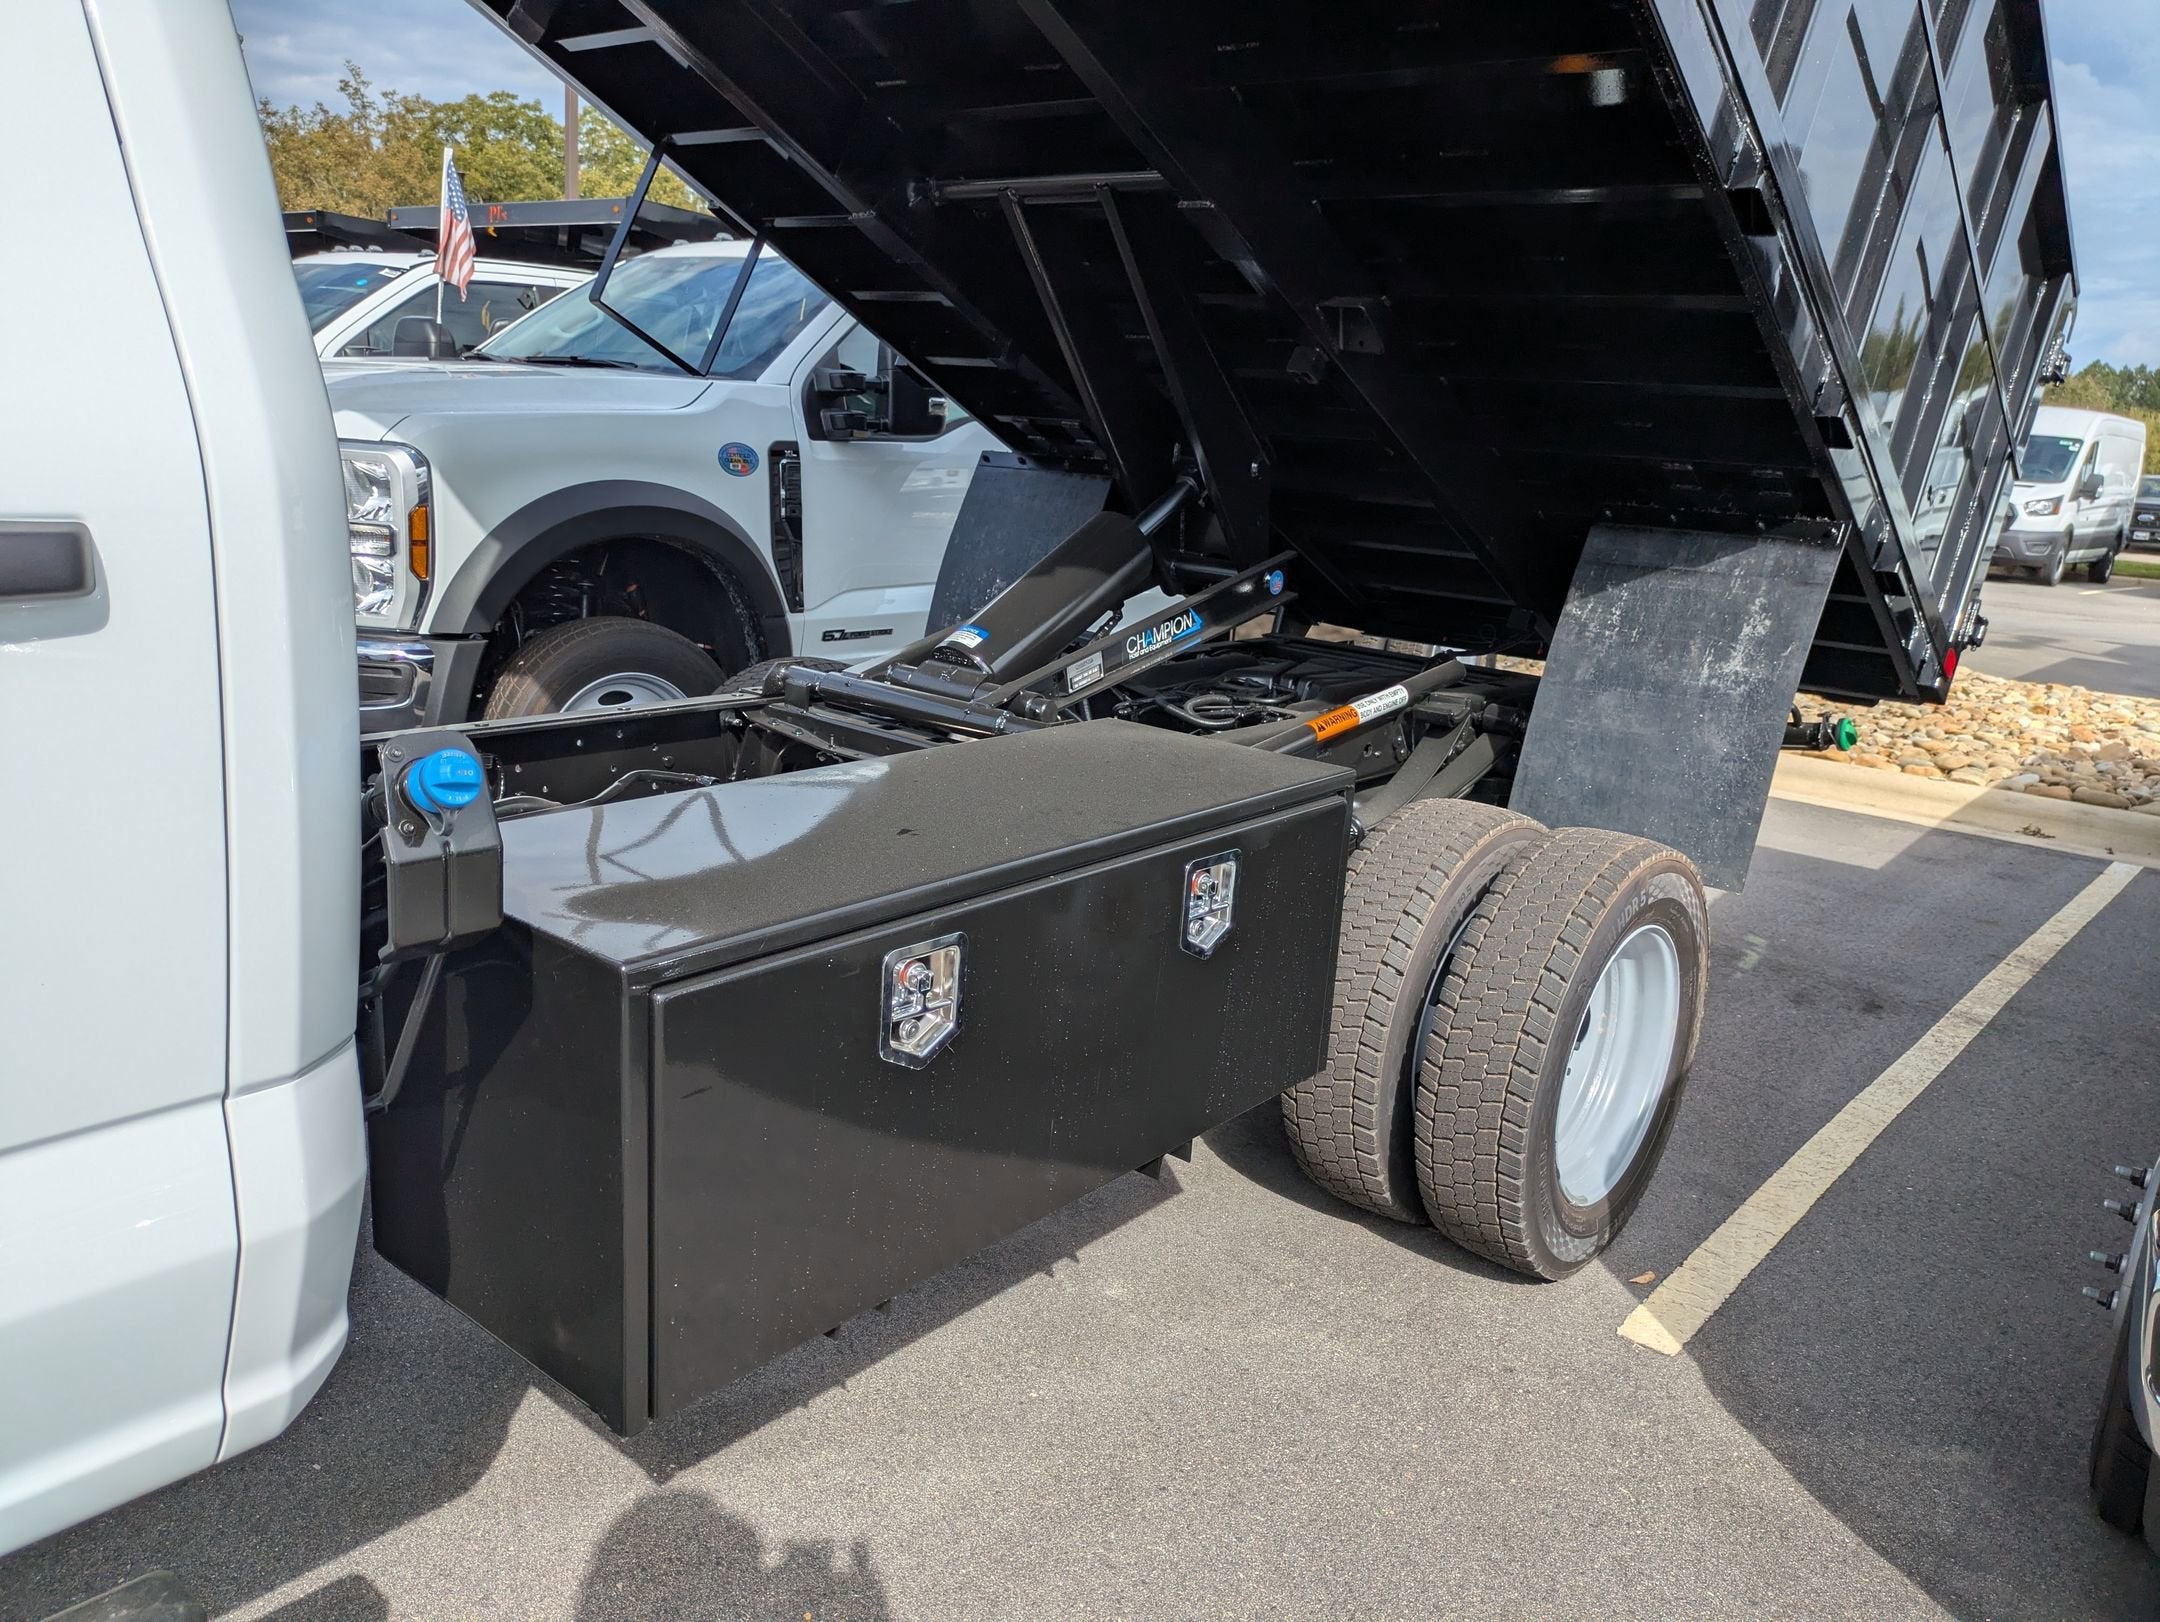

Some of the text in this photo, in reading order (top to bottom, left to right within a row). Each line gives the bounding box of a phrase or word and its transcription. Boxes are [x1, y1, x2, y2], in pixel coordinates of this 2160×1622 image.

[1126, 612, 1193, 654] CHAMPION
[1140, 645, 1150, 656] and
[1360, 695, 1407, 719] BODY AND ENGINE OFF
[1365, 697, 1378, 708] ONLY
[1378, 693, 1390, 704] WITH
[1389, 687, 1405, 699] EMPTY
[1322, 708, 1358, 729] WARNING
[1616, 889, 1647, 932] HDR 5
